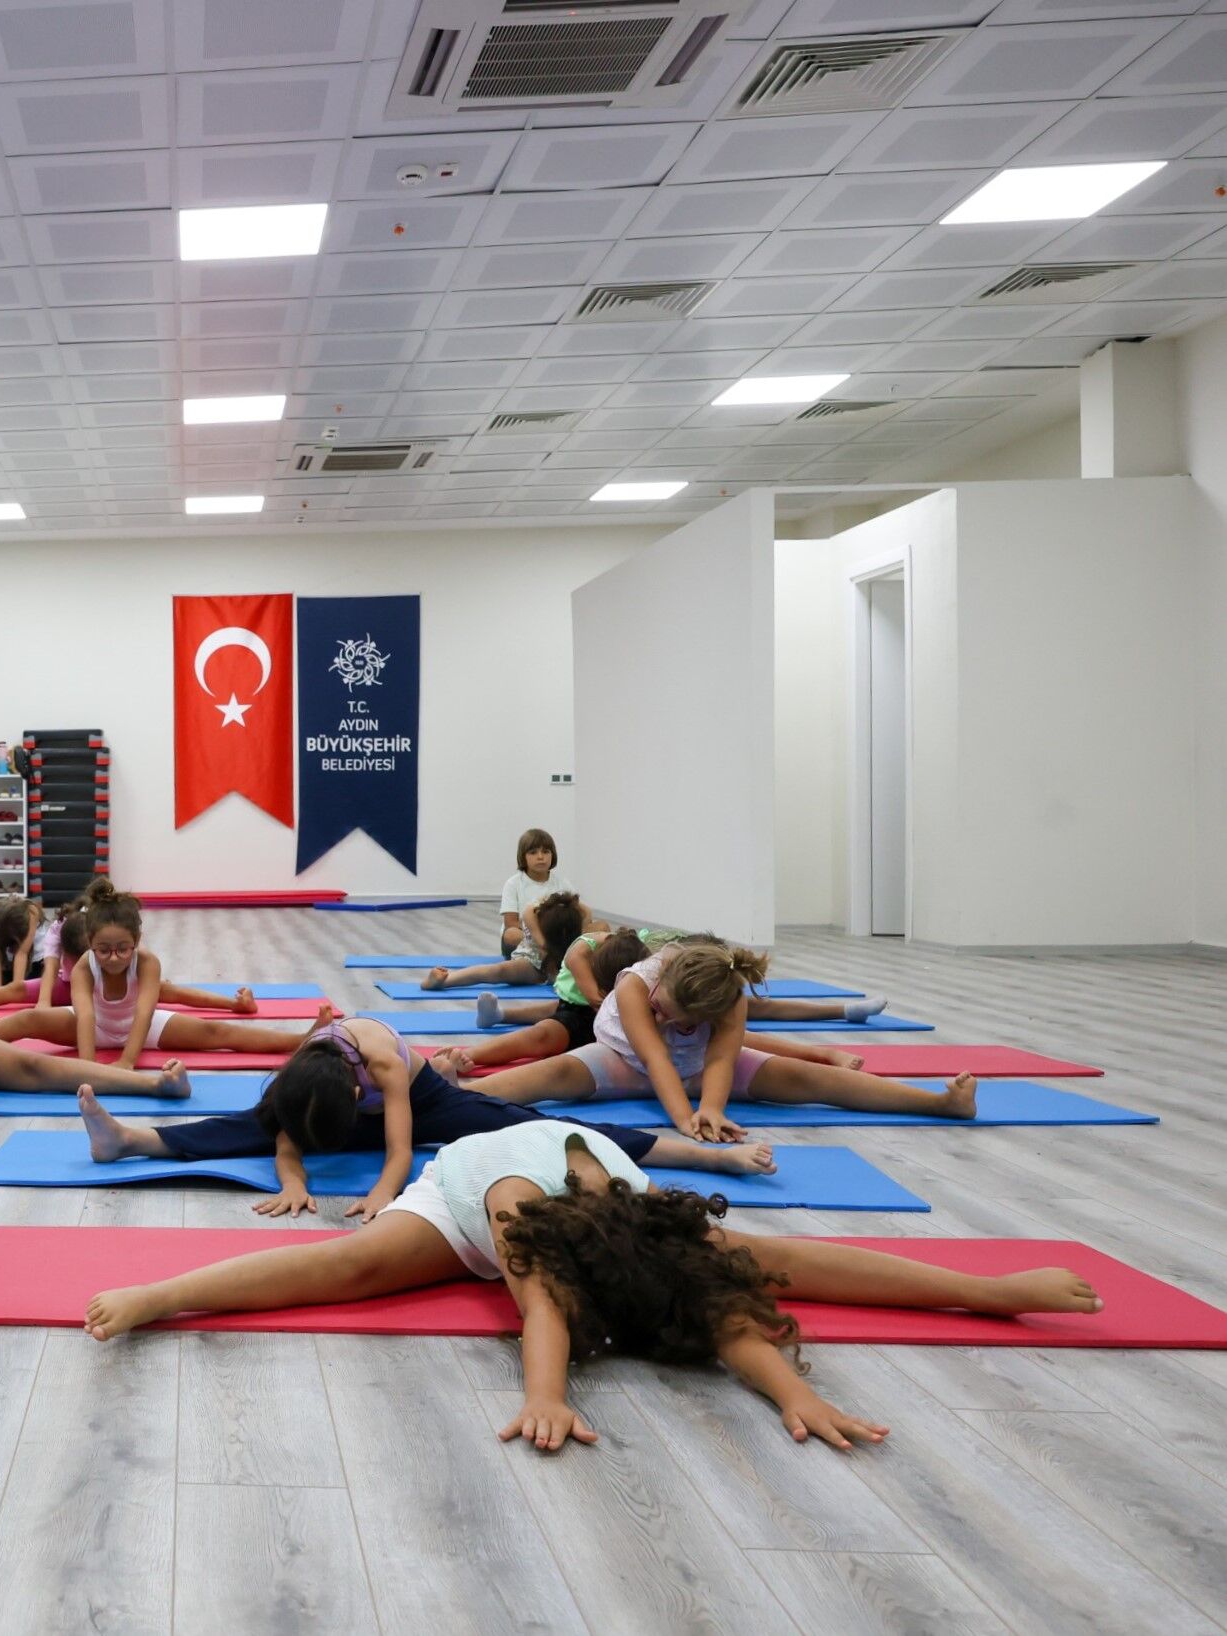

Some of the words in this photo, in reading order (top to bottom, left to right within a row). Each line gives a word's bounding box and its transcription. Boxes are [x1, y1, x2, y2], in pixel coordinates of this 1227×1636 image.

[347, 700, 370, 713] T.C.
[338, 719, 379, 732] AYDIN
[306, 734, 412, 757] BÜYÜKŞEHİR
[321, 756, 395, 771] BELEDİYESİ
